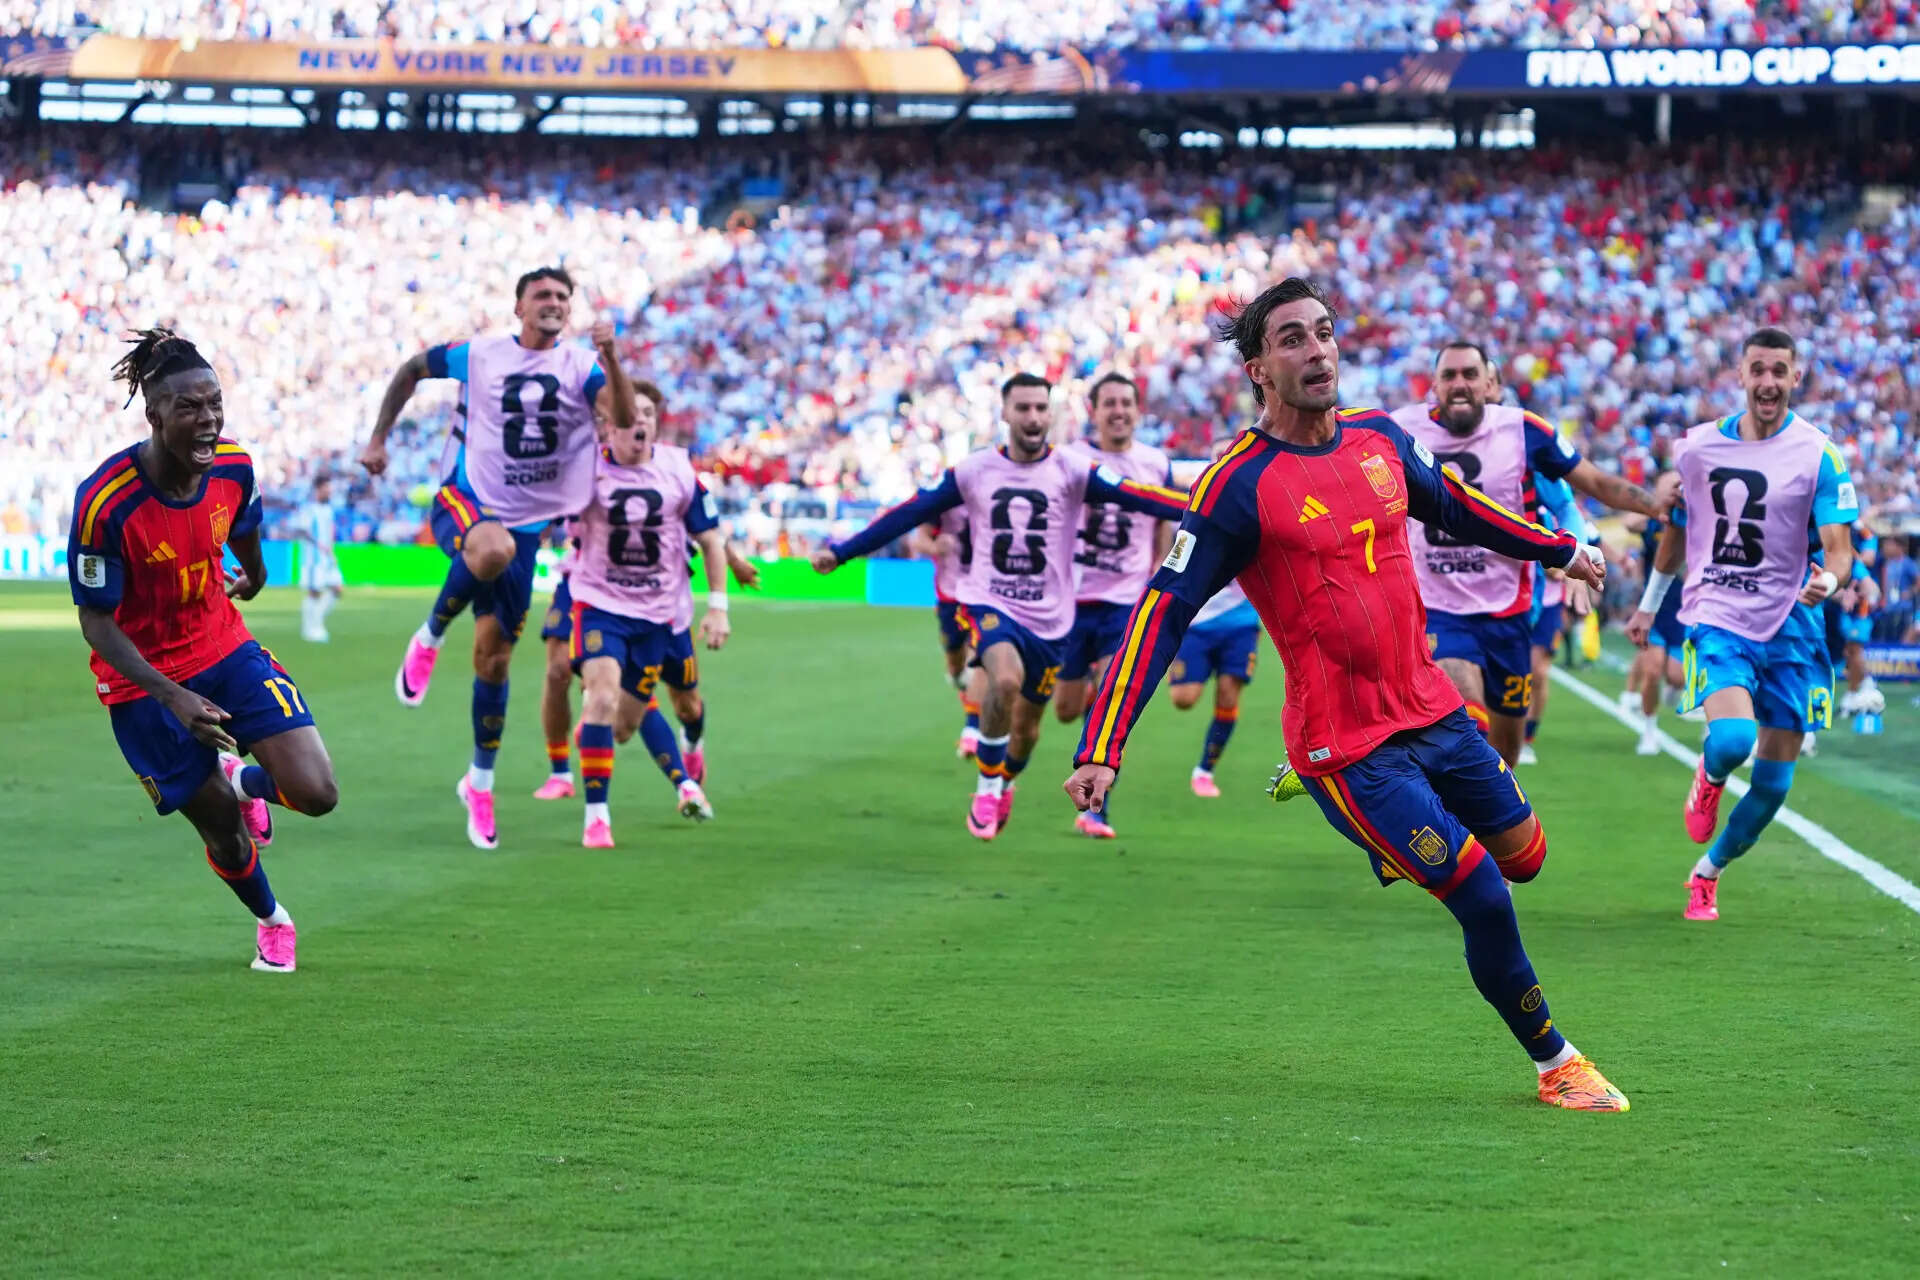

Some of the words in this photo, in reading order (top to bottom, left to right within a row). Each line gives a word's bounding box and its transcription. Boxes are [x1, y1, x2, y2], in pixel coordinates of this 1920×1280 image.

[300, 50, 378, 69] NEW
[394, 51, 487, 72] YORK
[502, 53, 583, 73] NEW
[595, 54, 736, 76] JERSEY
[1527, 49, 1612, 87] FIFA
[1610, 48, 1751, 87] WORLD
[1752, 46, 1831, 86] CUP
[1351, 518, 1377, 573] 7
[1718, 546, 1747, 561] FIFA
[180, 559, 209, 603] 17
[1427, 561, 1486, 575] 2026
[263, 677, 305, 718] 17
